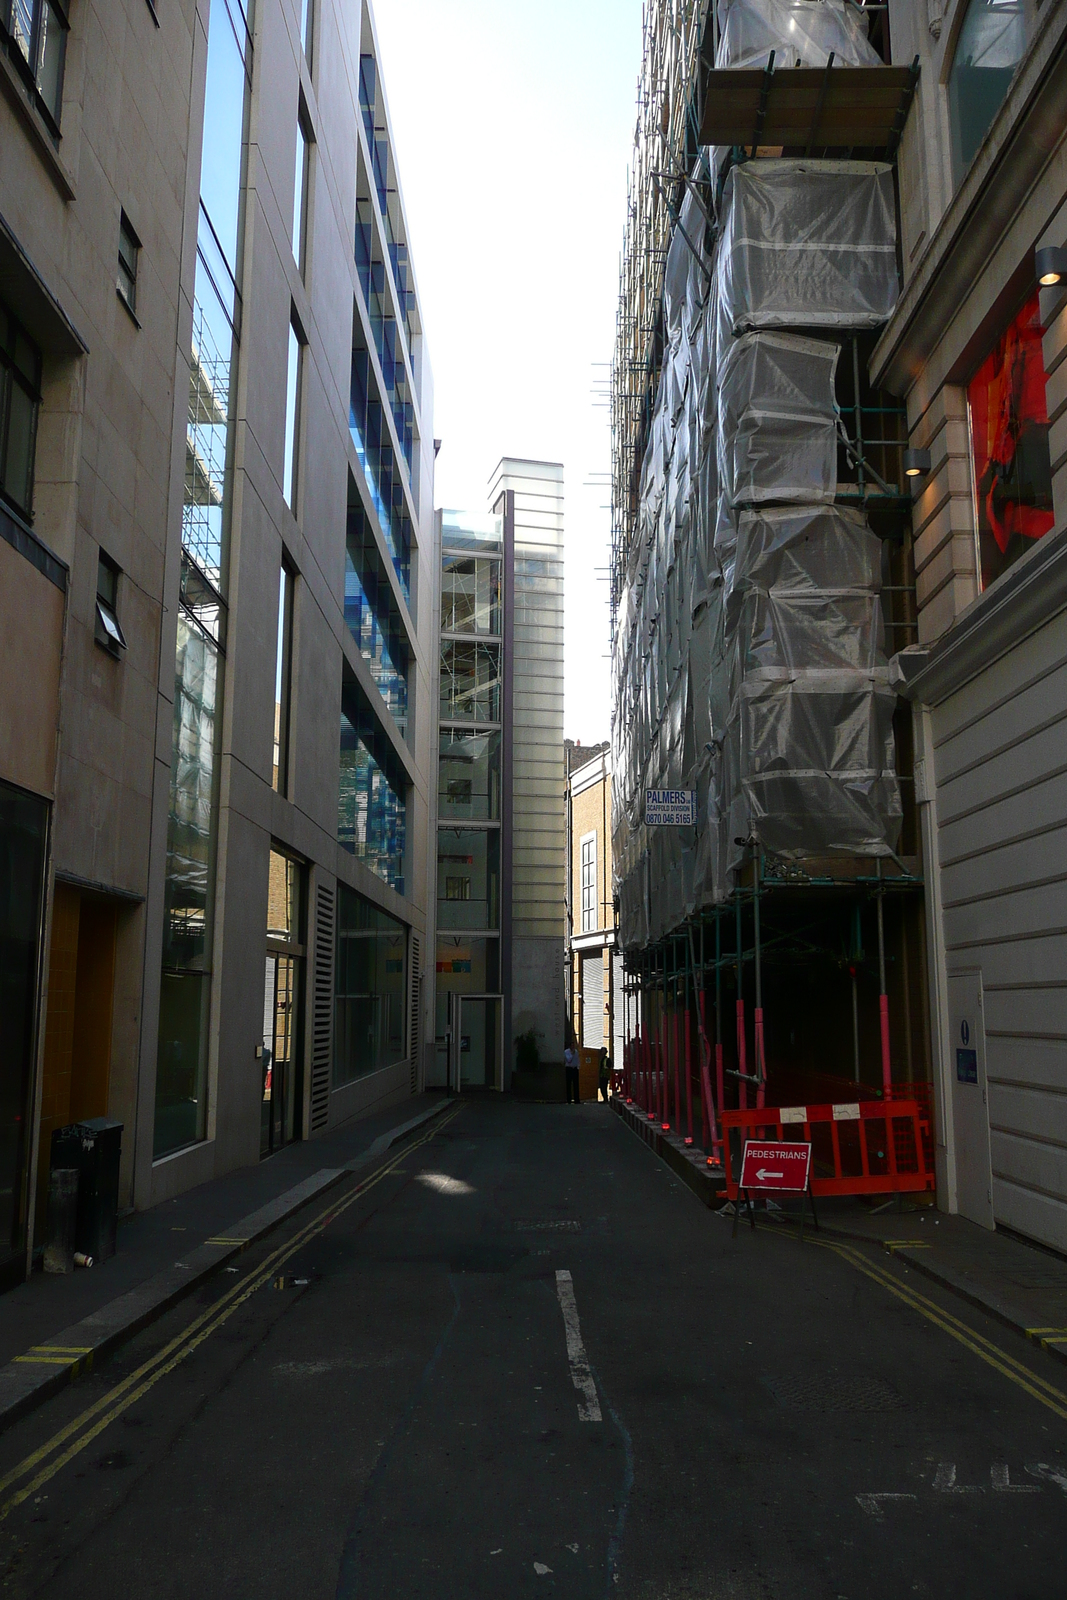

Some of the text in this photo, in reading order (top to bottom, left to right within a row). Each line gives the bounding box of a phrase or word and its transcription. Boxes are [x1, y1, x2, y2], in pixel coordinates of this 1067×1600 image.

[646, 790, 686, 804] PALMERS
[646, 804, 670, 812] SCAFFOLD
[646, 813, 691, 824] 0870 046 5165
[552, 947, 560, 979] house
[746, 1149, 807, 1160] PEDESTRIANS
